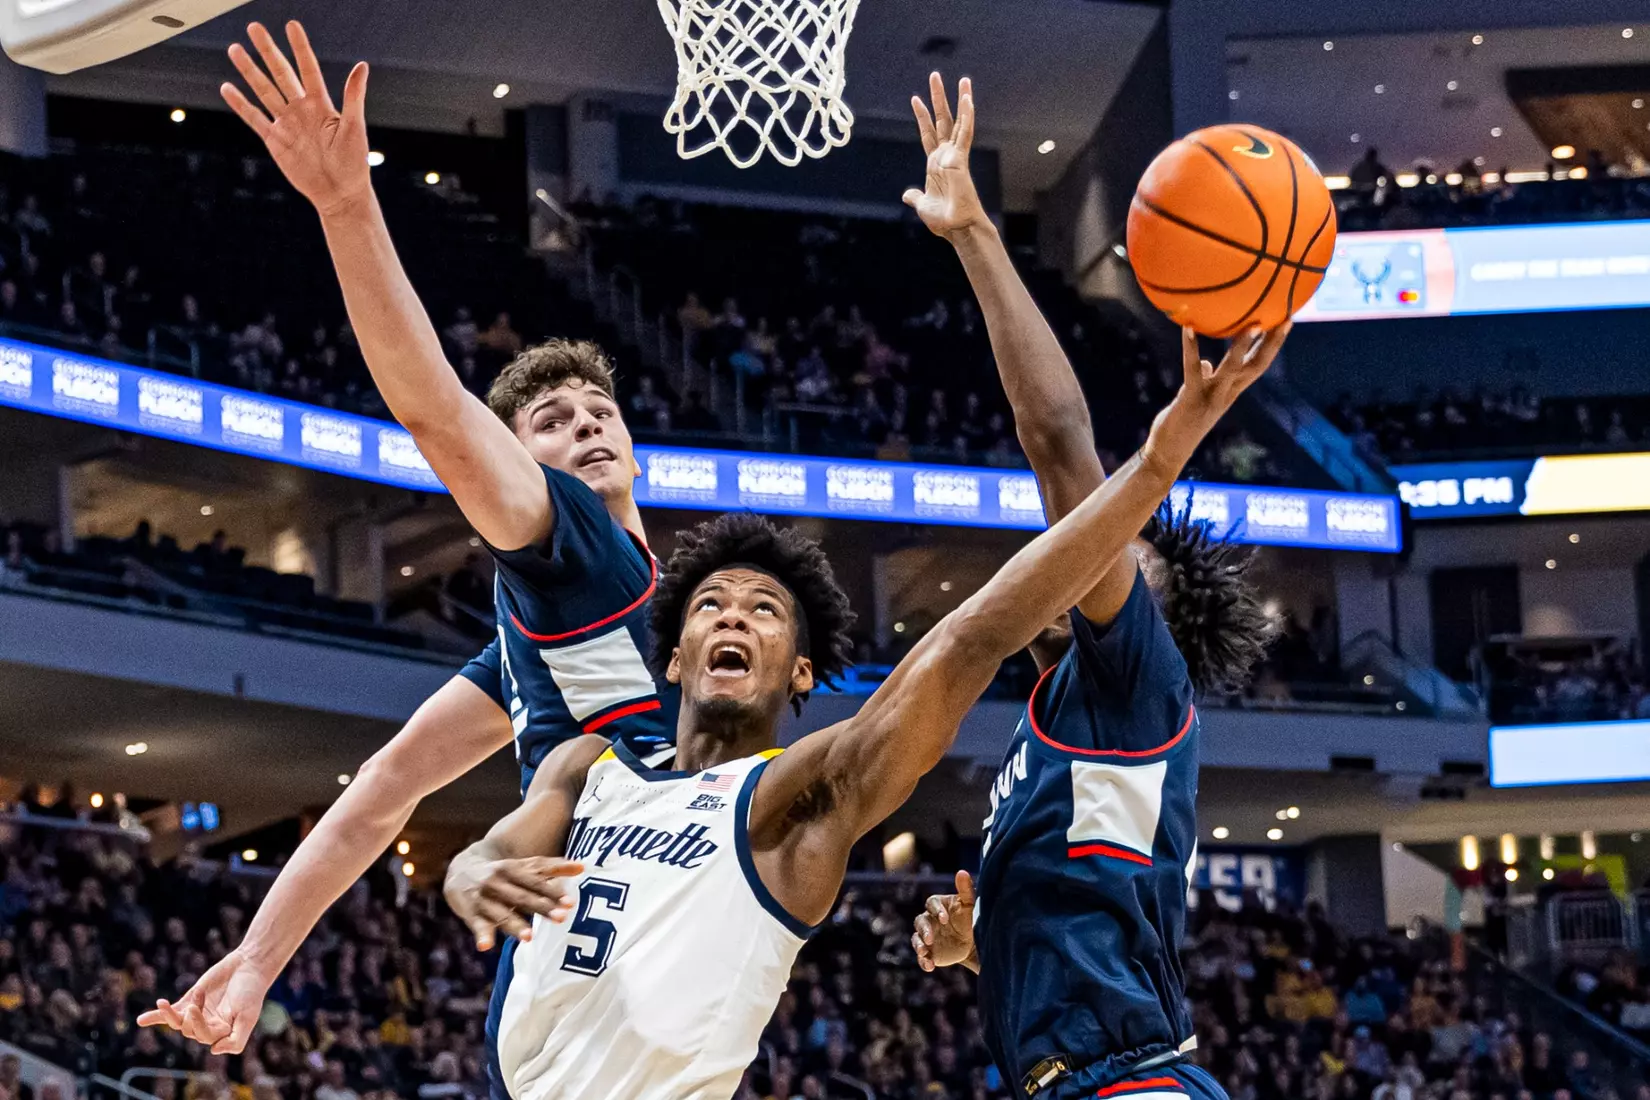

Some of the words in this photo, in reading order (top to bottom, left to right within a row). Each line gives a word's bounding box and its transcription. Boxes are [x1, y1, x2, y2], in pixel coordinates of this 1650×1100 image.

[1463, 477, 1514, 505] PM
[689, 801, 728, 811] EAST
[696, 793, 723, 803] BIG
[565, 816, 719, 869] Marquette
[559, 876, 631, 978] 5
